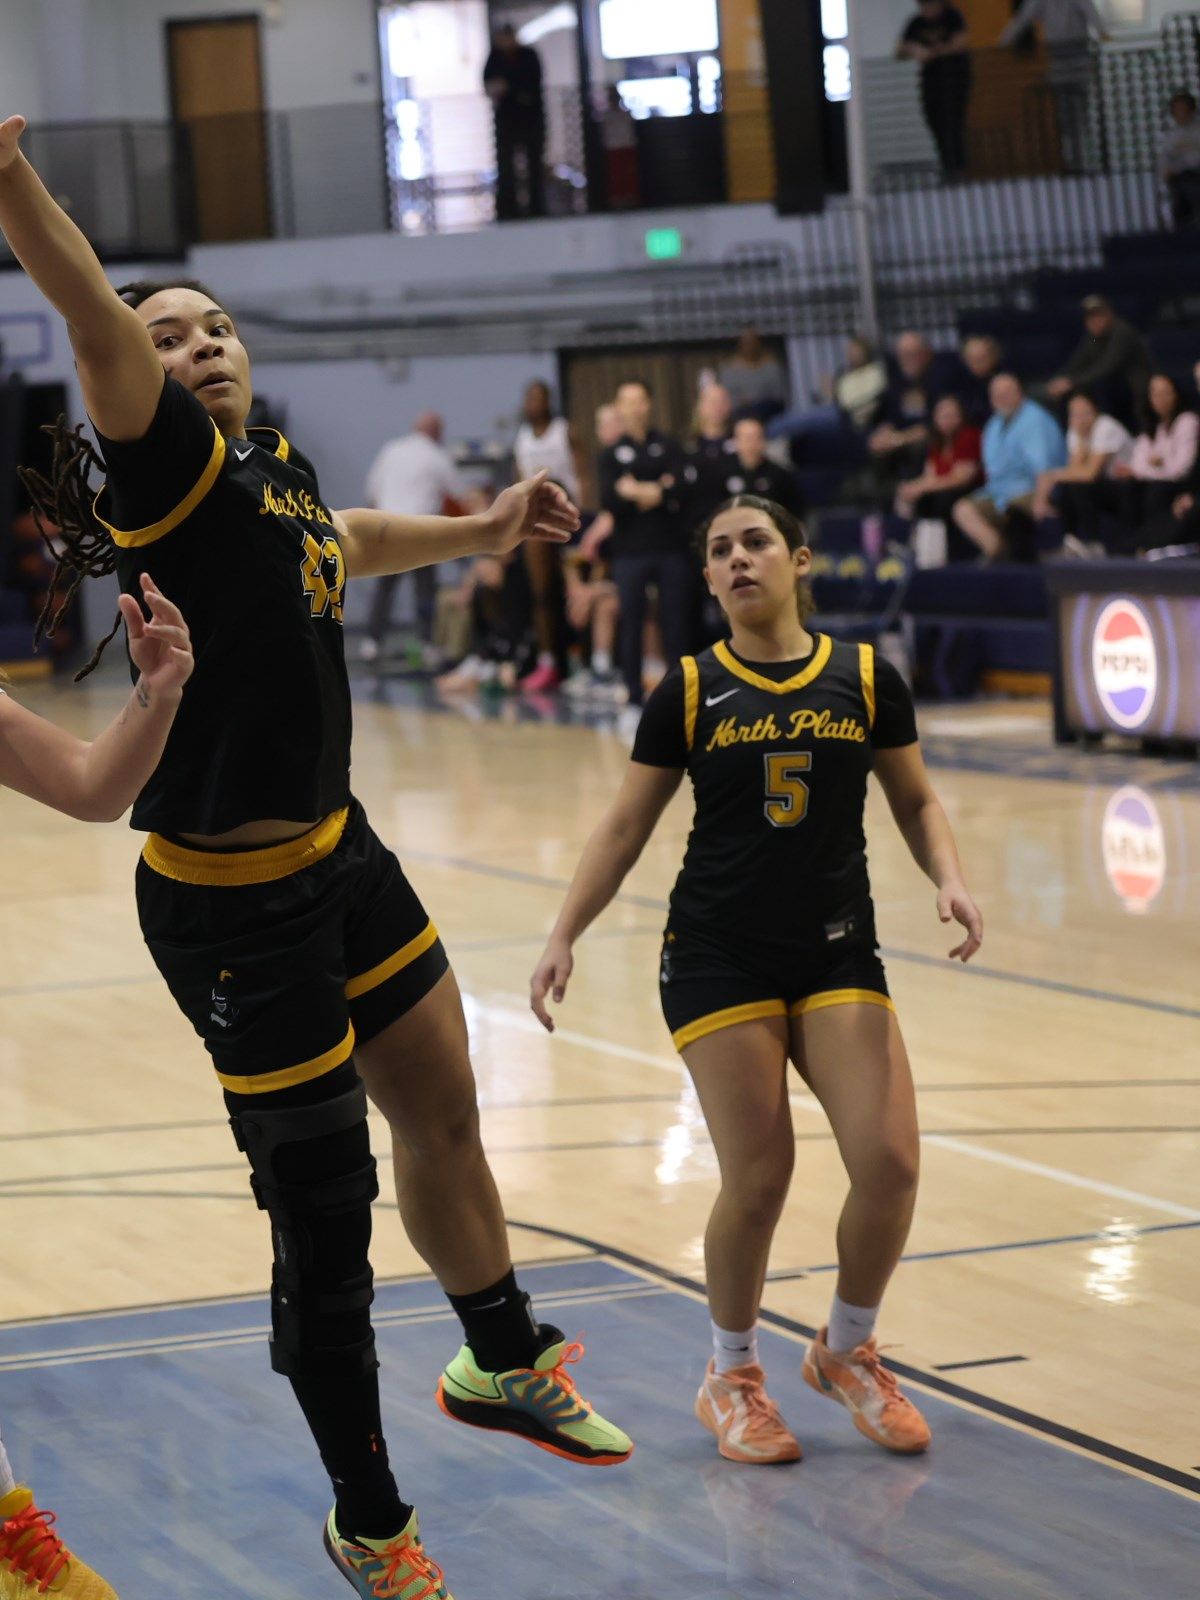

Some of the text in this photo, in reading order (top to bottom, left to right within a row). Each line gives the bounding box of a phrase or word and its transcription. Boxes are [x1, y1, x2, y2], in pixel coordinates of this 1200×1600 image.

[301, 530, 347, 625] 42
[706, 709, 866, 752] North Platte
[763, 751, 812, 828] 5
